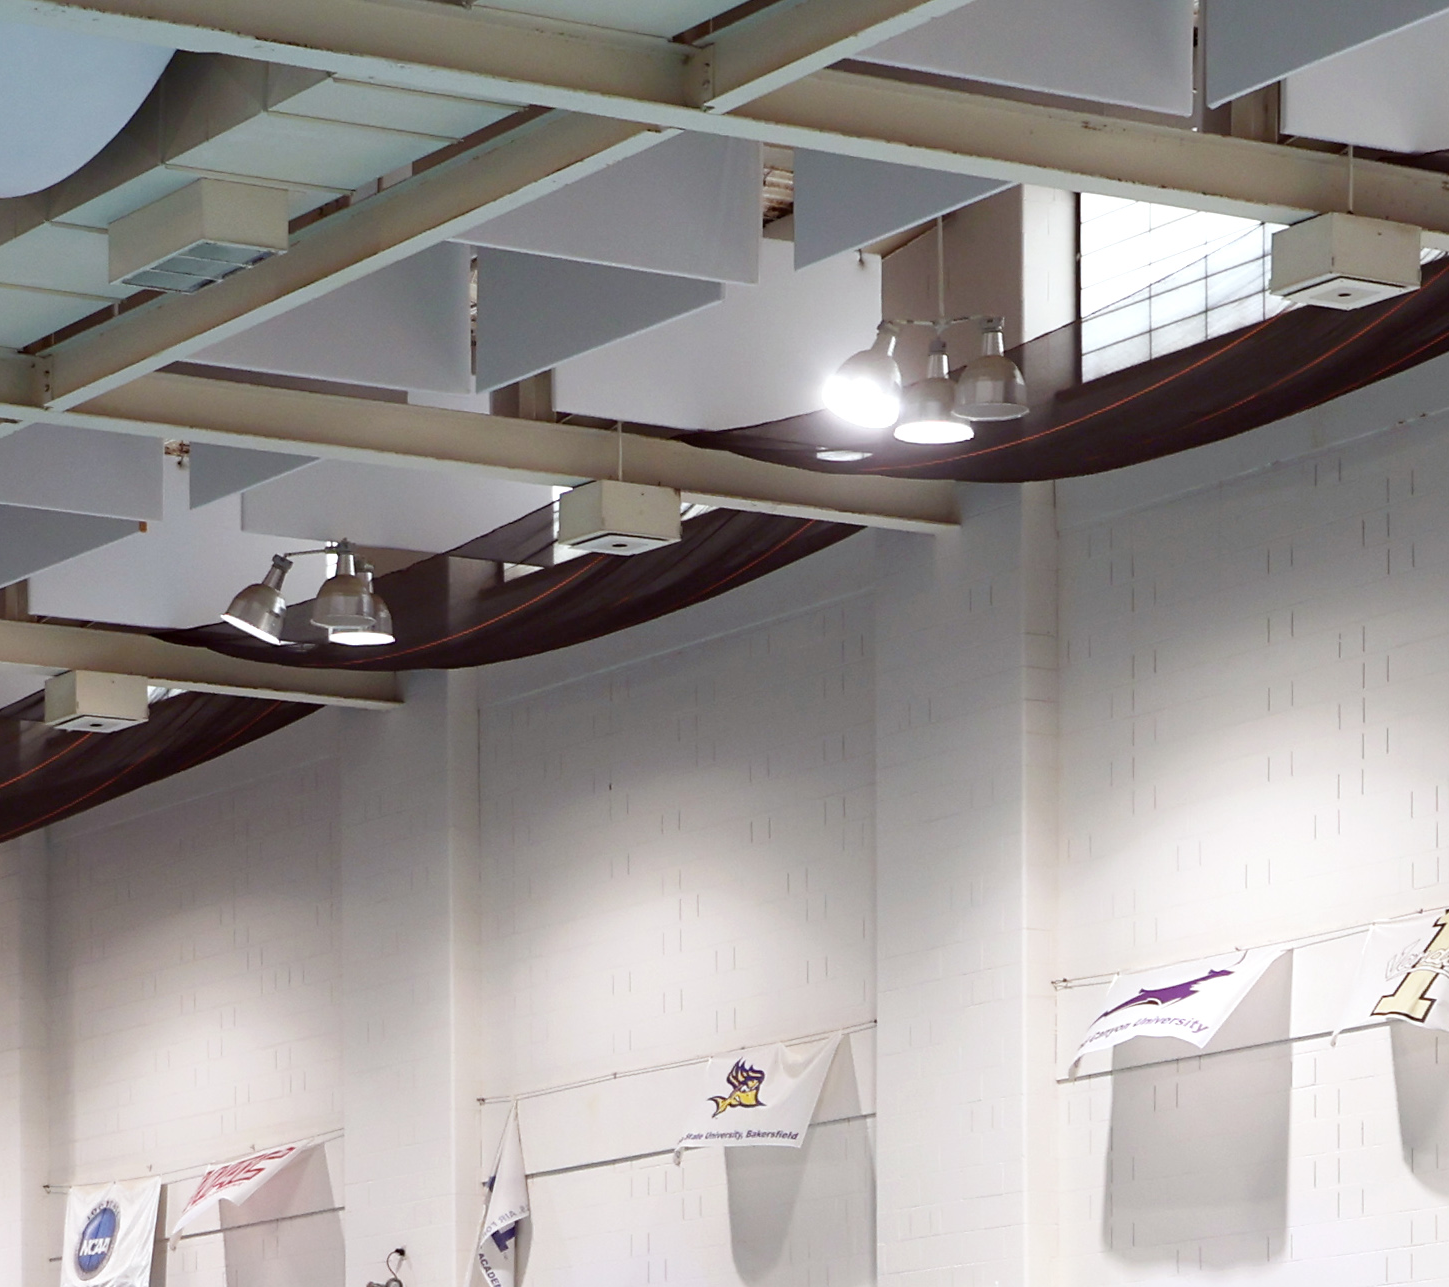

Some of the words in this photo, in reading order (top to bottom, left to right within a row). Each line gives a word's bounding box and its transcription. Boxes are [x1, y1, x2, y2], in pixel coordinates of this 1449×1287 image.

[1133, 1016, 1209, 1033] University
[745, 1130, 799, 1140] Bakersfield
[79, 1236, 111, 1257] NCAA
